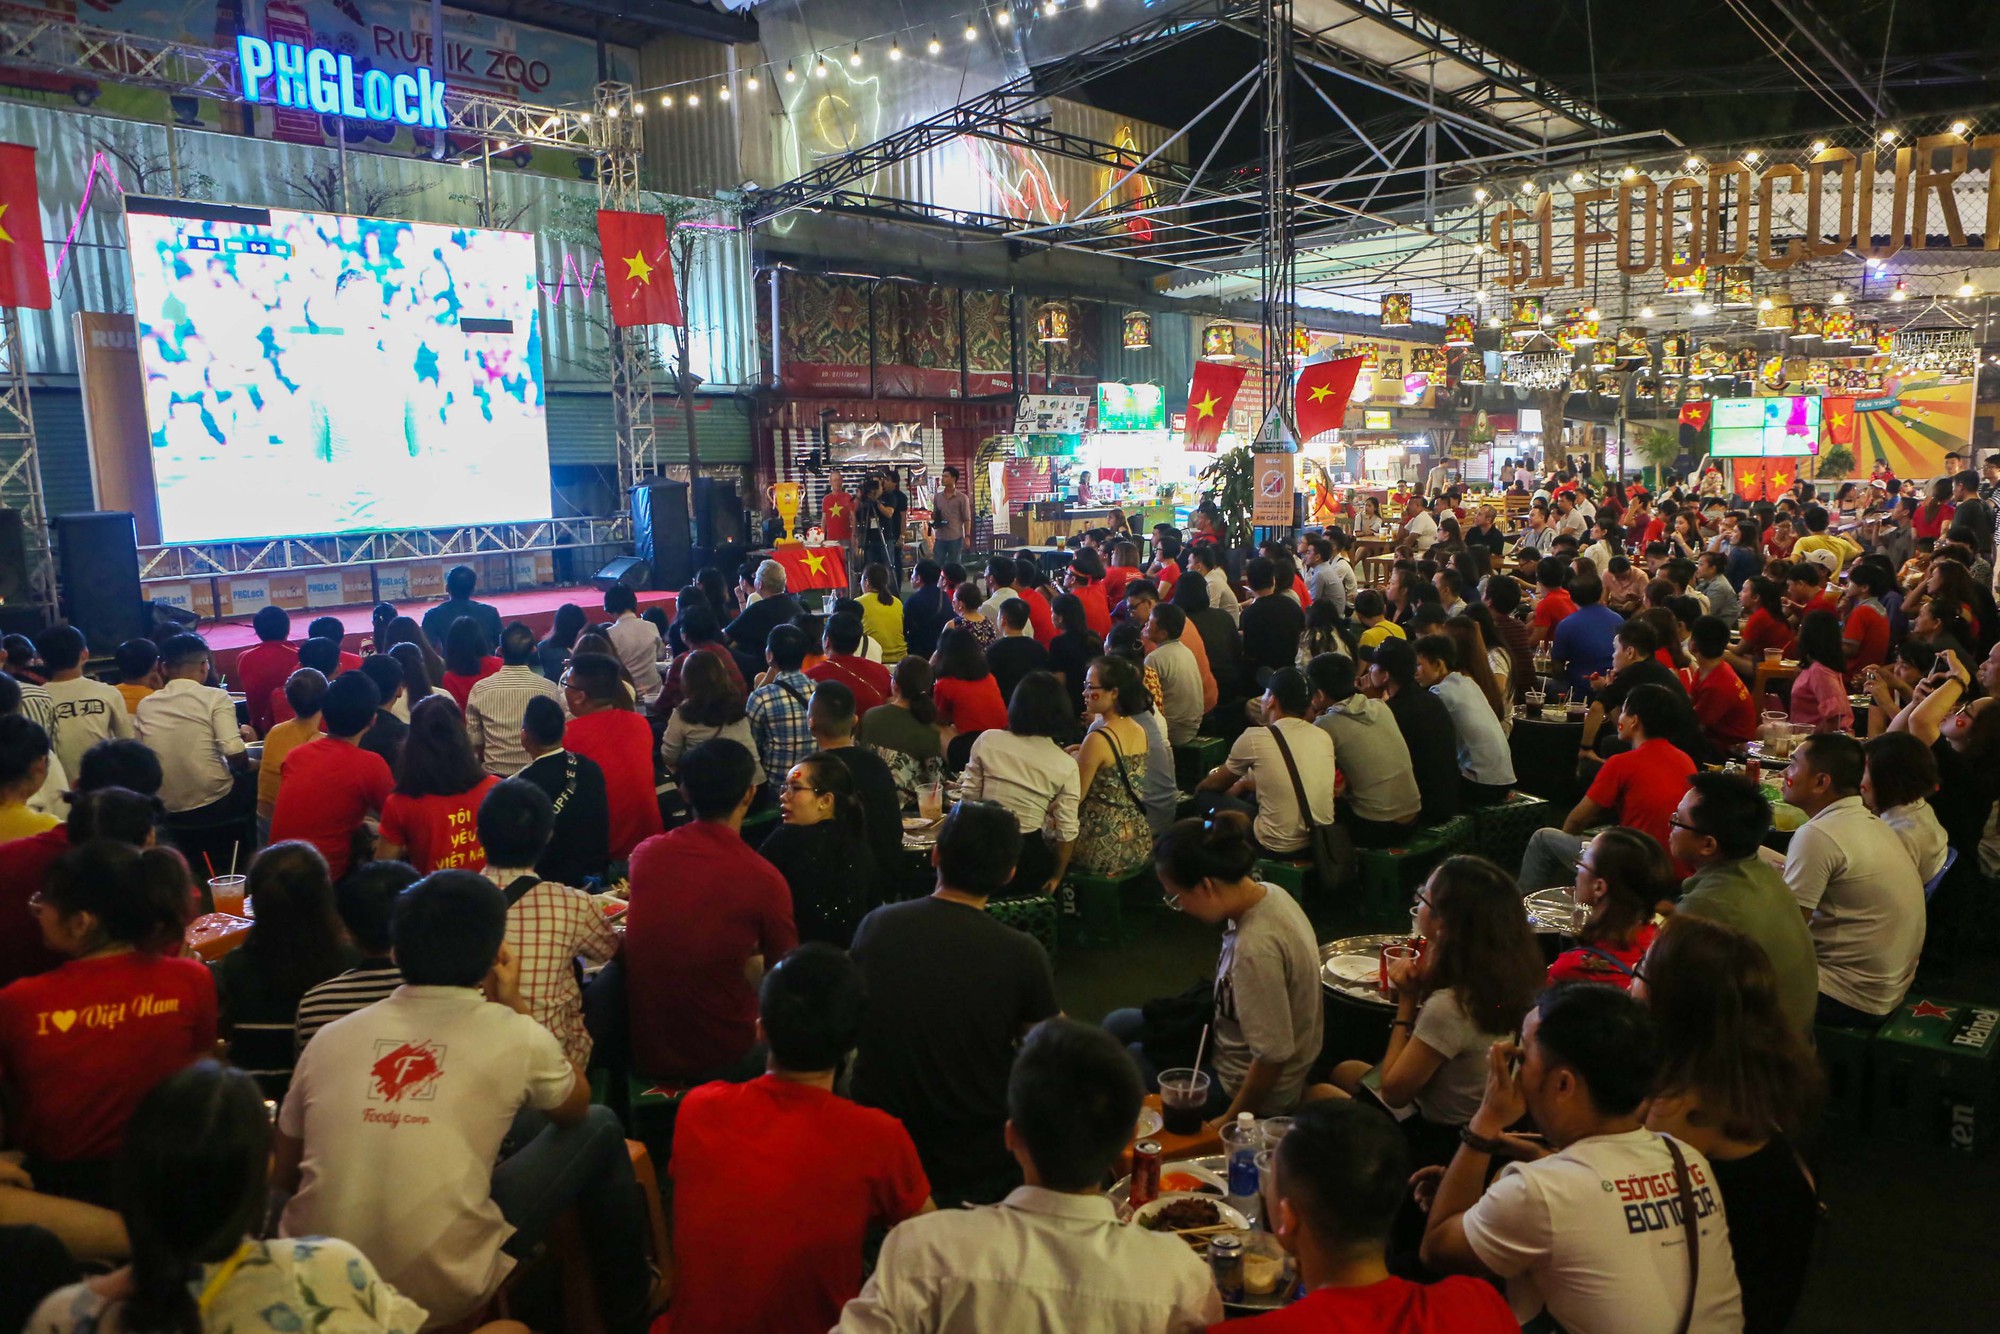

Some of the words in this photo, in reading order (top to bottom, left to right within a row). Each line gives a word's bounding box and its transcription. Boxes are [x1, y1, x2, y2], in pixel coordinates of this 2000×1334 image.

[331, 117, 386, 131] CNEMA
[448, 808, 471, 827] TÔI
[451, 828, 476, 848] YÊU
[37, 1012, 49, 1035] I
[81, 1002, 126, 1030] Việt
[131, 994, 179, 1018] Nam
[362, 1108, 400, 1129] Foody
